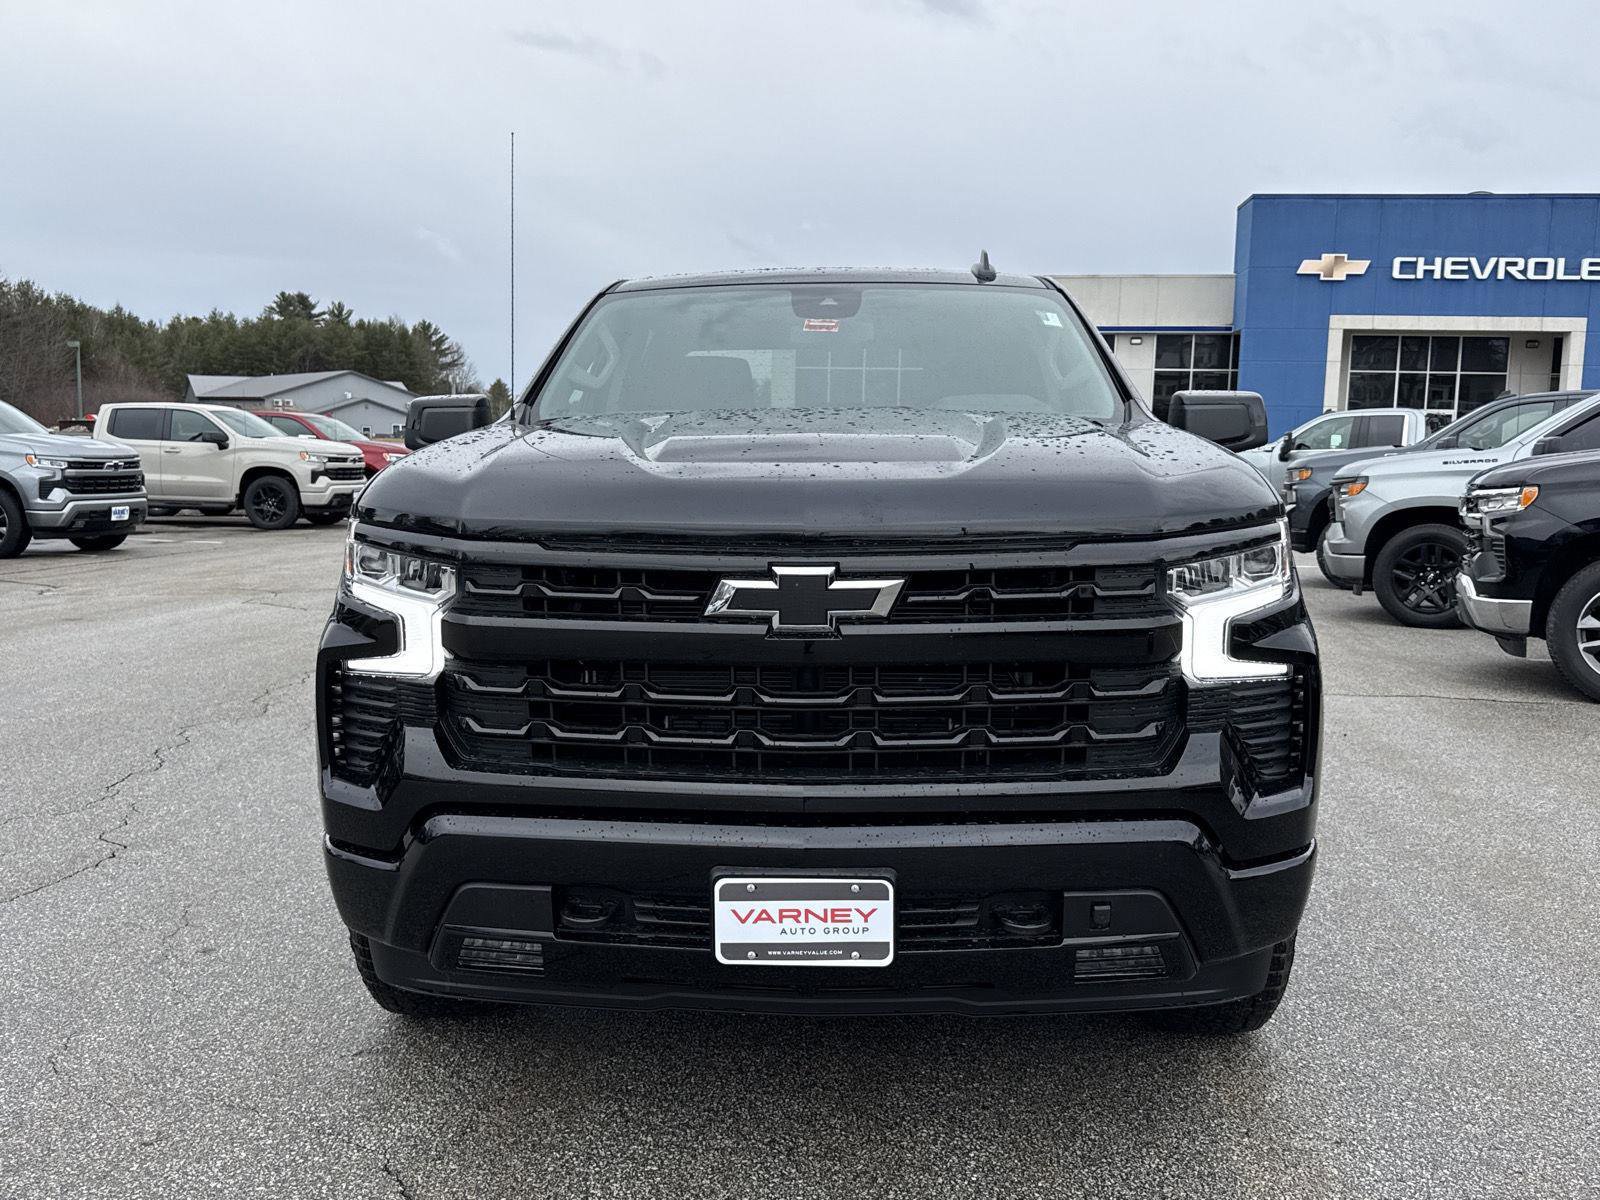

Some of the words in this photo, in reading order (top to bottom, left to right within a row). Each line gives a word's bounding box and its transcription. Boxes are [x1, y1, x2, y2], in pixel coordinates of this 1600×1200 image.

[731, 908, 878, 924] VARNEY
[780, 927, 816, 935] AUTO
[823, 926, 870, 935] GROUP
